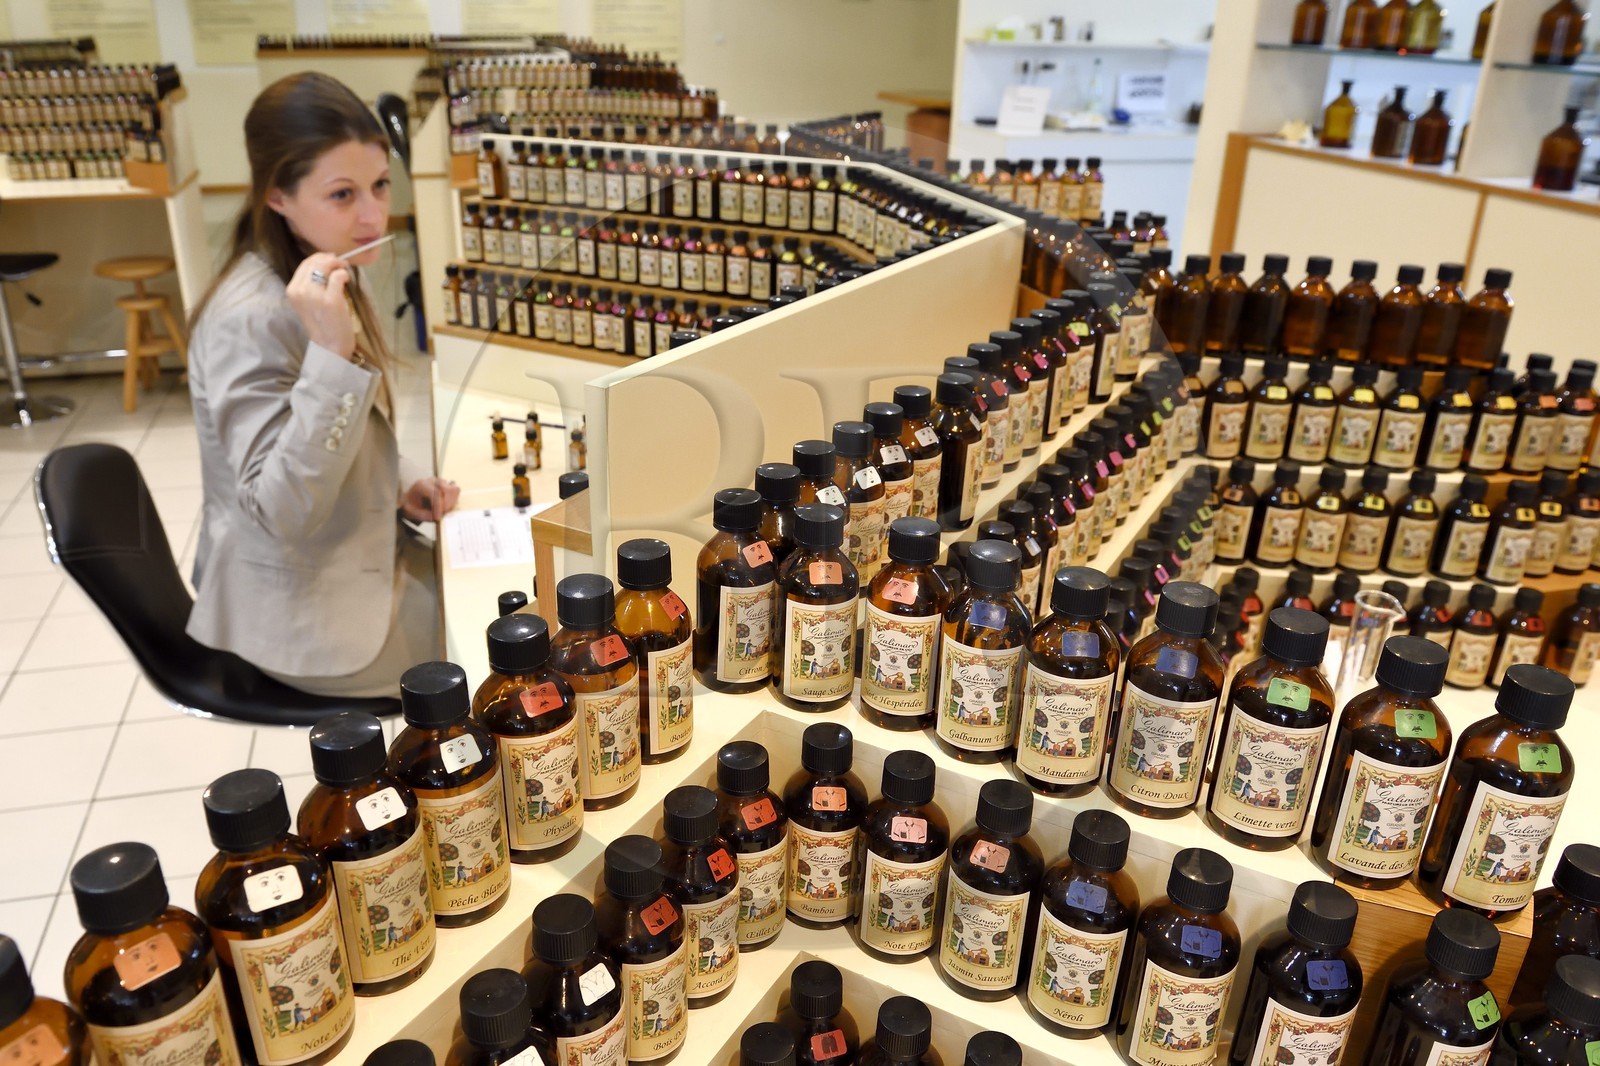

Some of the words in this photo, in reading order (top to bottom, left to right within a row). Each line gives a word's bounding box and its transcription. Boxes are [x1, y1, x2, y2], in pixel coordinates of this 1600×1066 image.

[874, 631, 919, 648] Galimard
[738, 666, 763, 676] Citron
[955, 666, 1004, 682] Galimard
[801, 687, 827, 699] Sauge
[879, 695, 924, 709] Hespéridée
[1040, 696, 1092, 711] Galimard
[1137, 717, 1192, 735] Galimard
[948, 728, 992, 744] Galbanum
[1243, 742, 1302, 761] Galimard
[1038, 765, 1089, 778] Mandarine
[1130, 784, 1161, 799] Citron
[1162, 791, 1189, 800] Doux
[1370, 788, 1429, 803] Galimard
[543, 815, 577, 837] Physalis
[1233, 811, 1273, 828] Limette
[1274, 820, 1297, 829] verte
[1340, 852, 1387, 870] Lavande
[1388, 861, 1403, 870] des
[448, 895, 479, 908] Pêche
[1492, 894, 1527, 904] Tomate
[800, 903, 835, 914] Bambou
[746, 927, 771, 940] Œillet
[884, 941, 905, 950] Note
[1050, 941, 1102, 965] Galimard
[392, 952, 412, 967] Thé
[692, 976, 724, 991] Accord
[974, 973, 1013, 984] Sauvage
[1053, 1007, 1084, 1022] Néroli
[301, 1032, 330, 1053] Note
[653, 1037, 673, 1051] Bois
